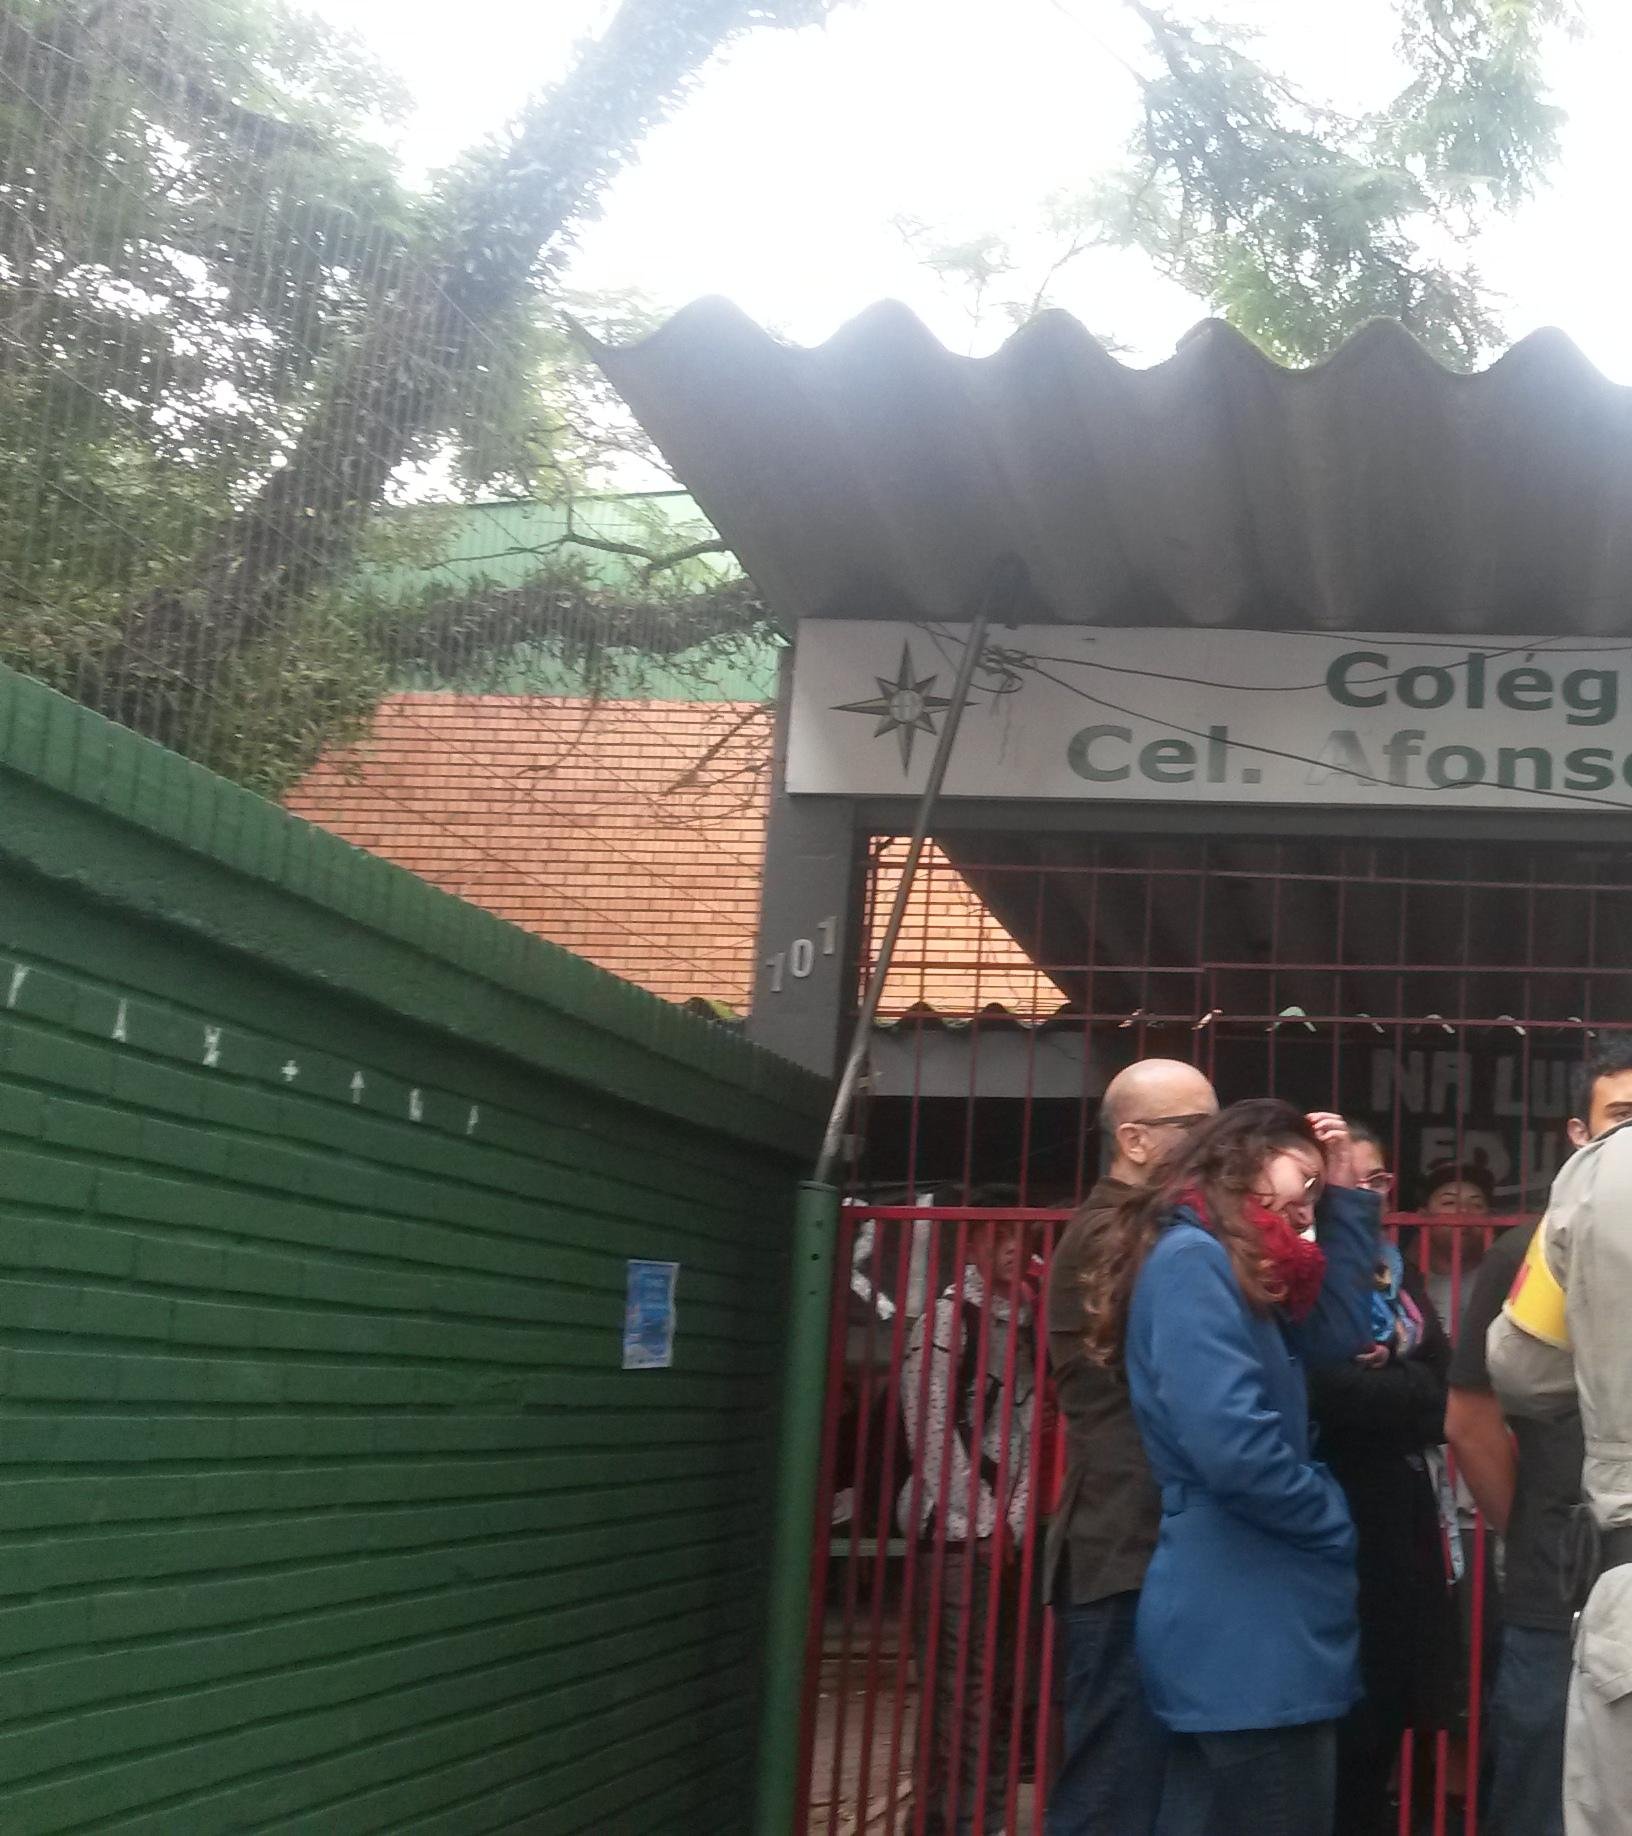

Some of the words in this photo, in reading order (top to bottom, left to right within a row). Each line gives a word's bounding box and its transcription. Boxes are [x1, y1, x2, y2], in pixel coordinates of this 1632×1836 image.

[1067, 725, 1262, 784] Cel.
[1492, 1054, 1587, 1117] LU
[1420, 1125, 1558, 1188] EDU
